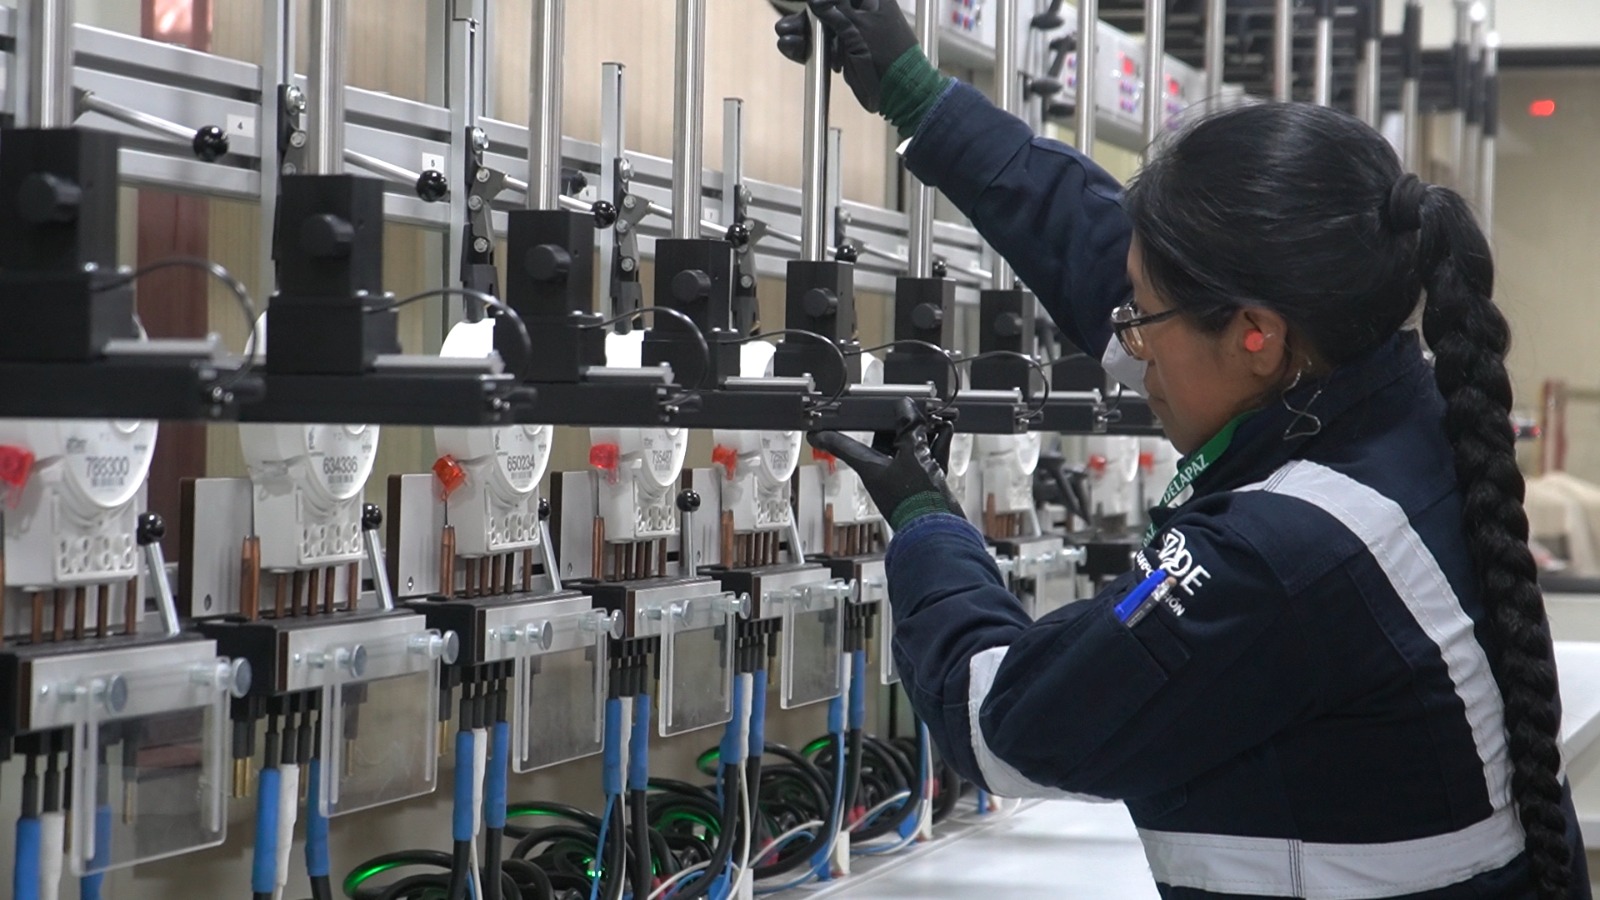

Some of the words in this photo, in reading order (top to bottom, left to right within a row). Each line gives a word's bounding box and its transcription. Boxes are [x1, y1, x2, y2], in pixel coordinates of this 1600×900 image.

[237, 121, 244, 130] 4
[323, 455, 358, 475] 634336
[507, 454, 536, 472] 650234
[1162, 453, 1210, 504] DELAPAZ
